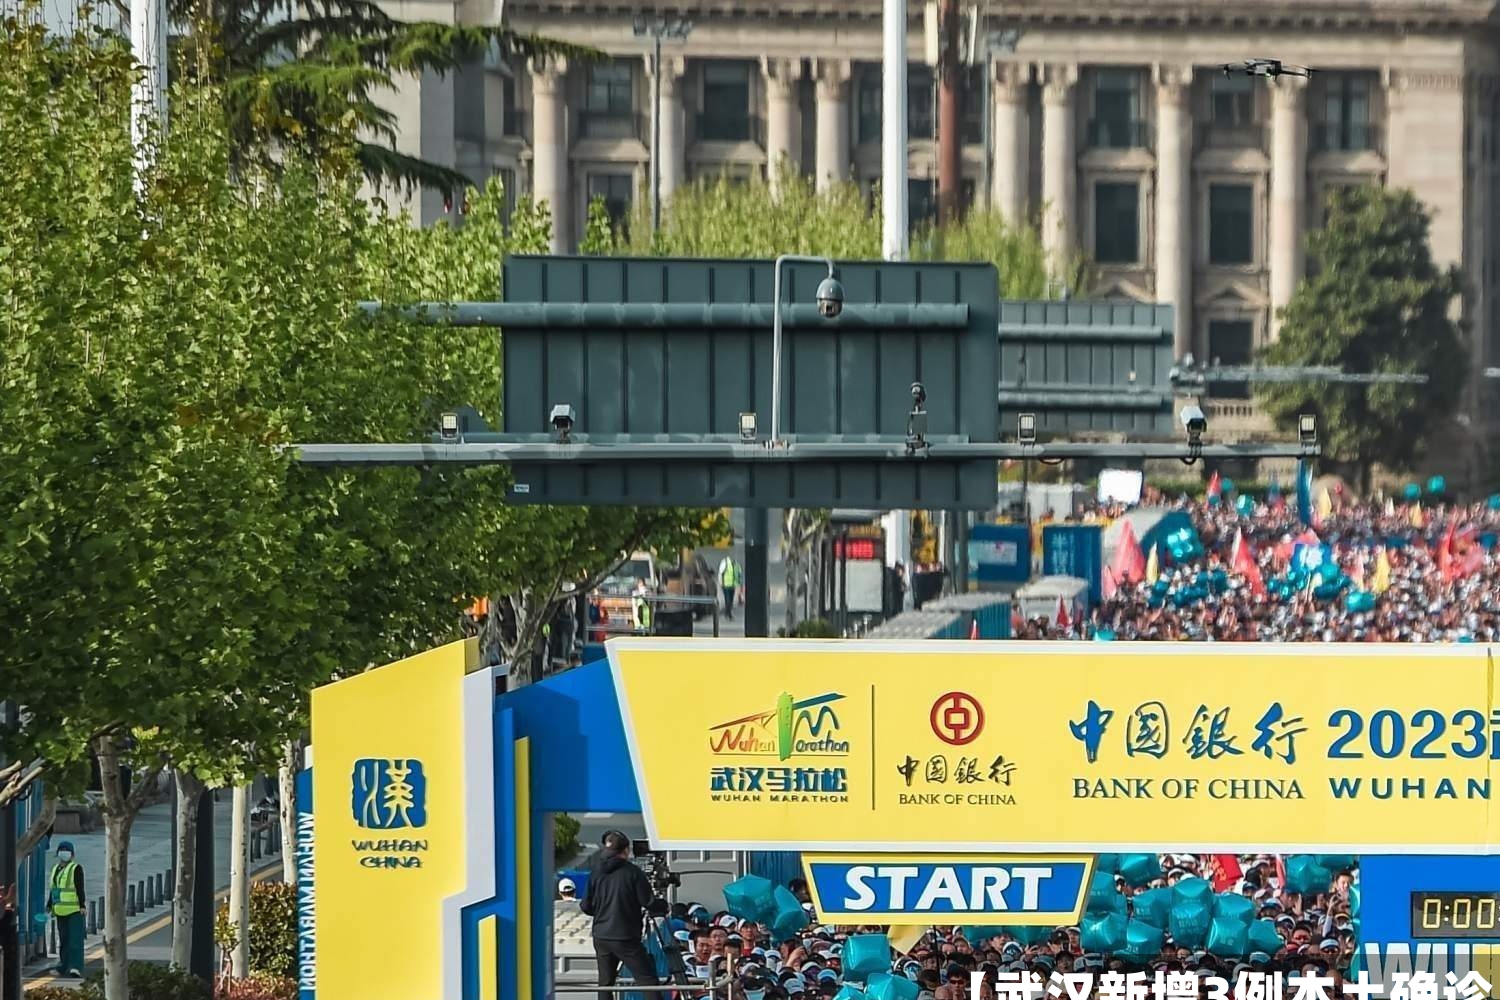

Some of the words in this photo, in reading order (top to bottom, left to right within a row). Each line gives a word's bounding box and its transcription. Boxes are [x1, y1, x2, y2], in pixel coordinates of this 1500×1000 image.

[710, 767, 848, 792] 武汉马拉松
[1328, 777, 1491, 799] WUHAN
[1072, 778, 1153, 799] BANK
[1162, 778, 1198, 799] OF
[1217, 778, 1305, 799] CHINA
[711, 794, 761, 803] WUHAN
[769, 794, 849, 803] MARATHON
[899, 793, 940, 805] BANK
[944, 793, 963, 805] OF
[967, 793, 1016, 805] CHINA
[351, 839, 428, 852] WUHAN
[359, 866, 423, 878] CHINA
[844, 866, 1052, 910] START
